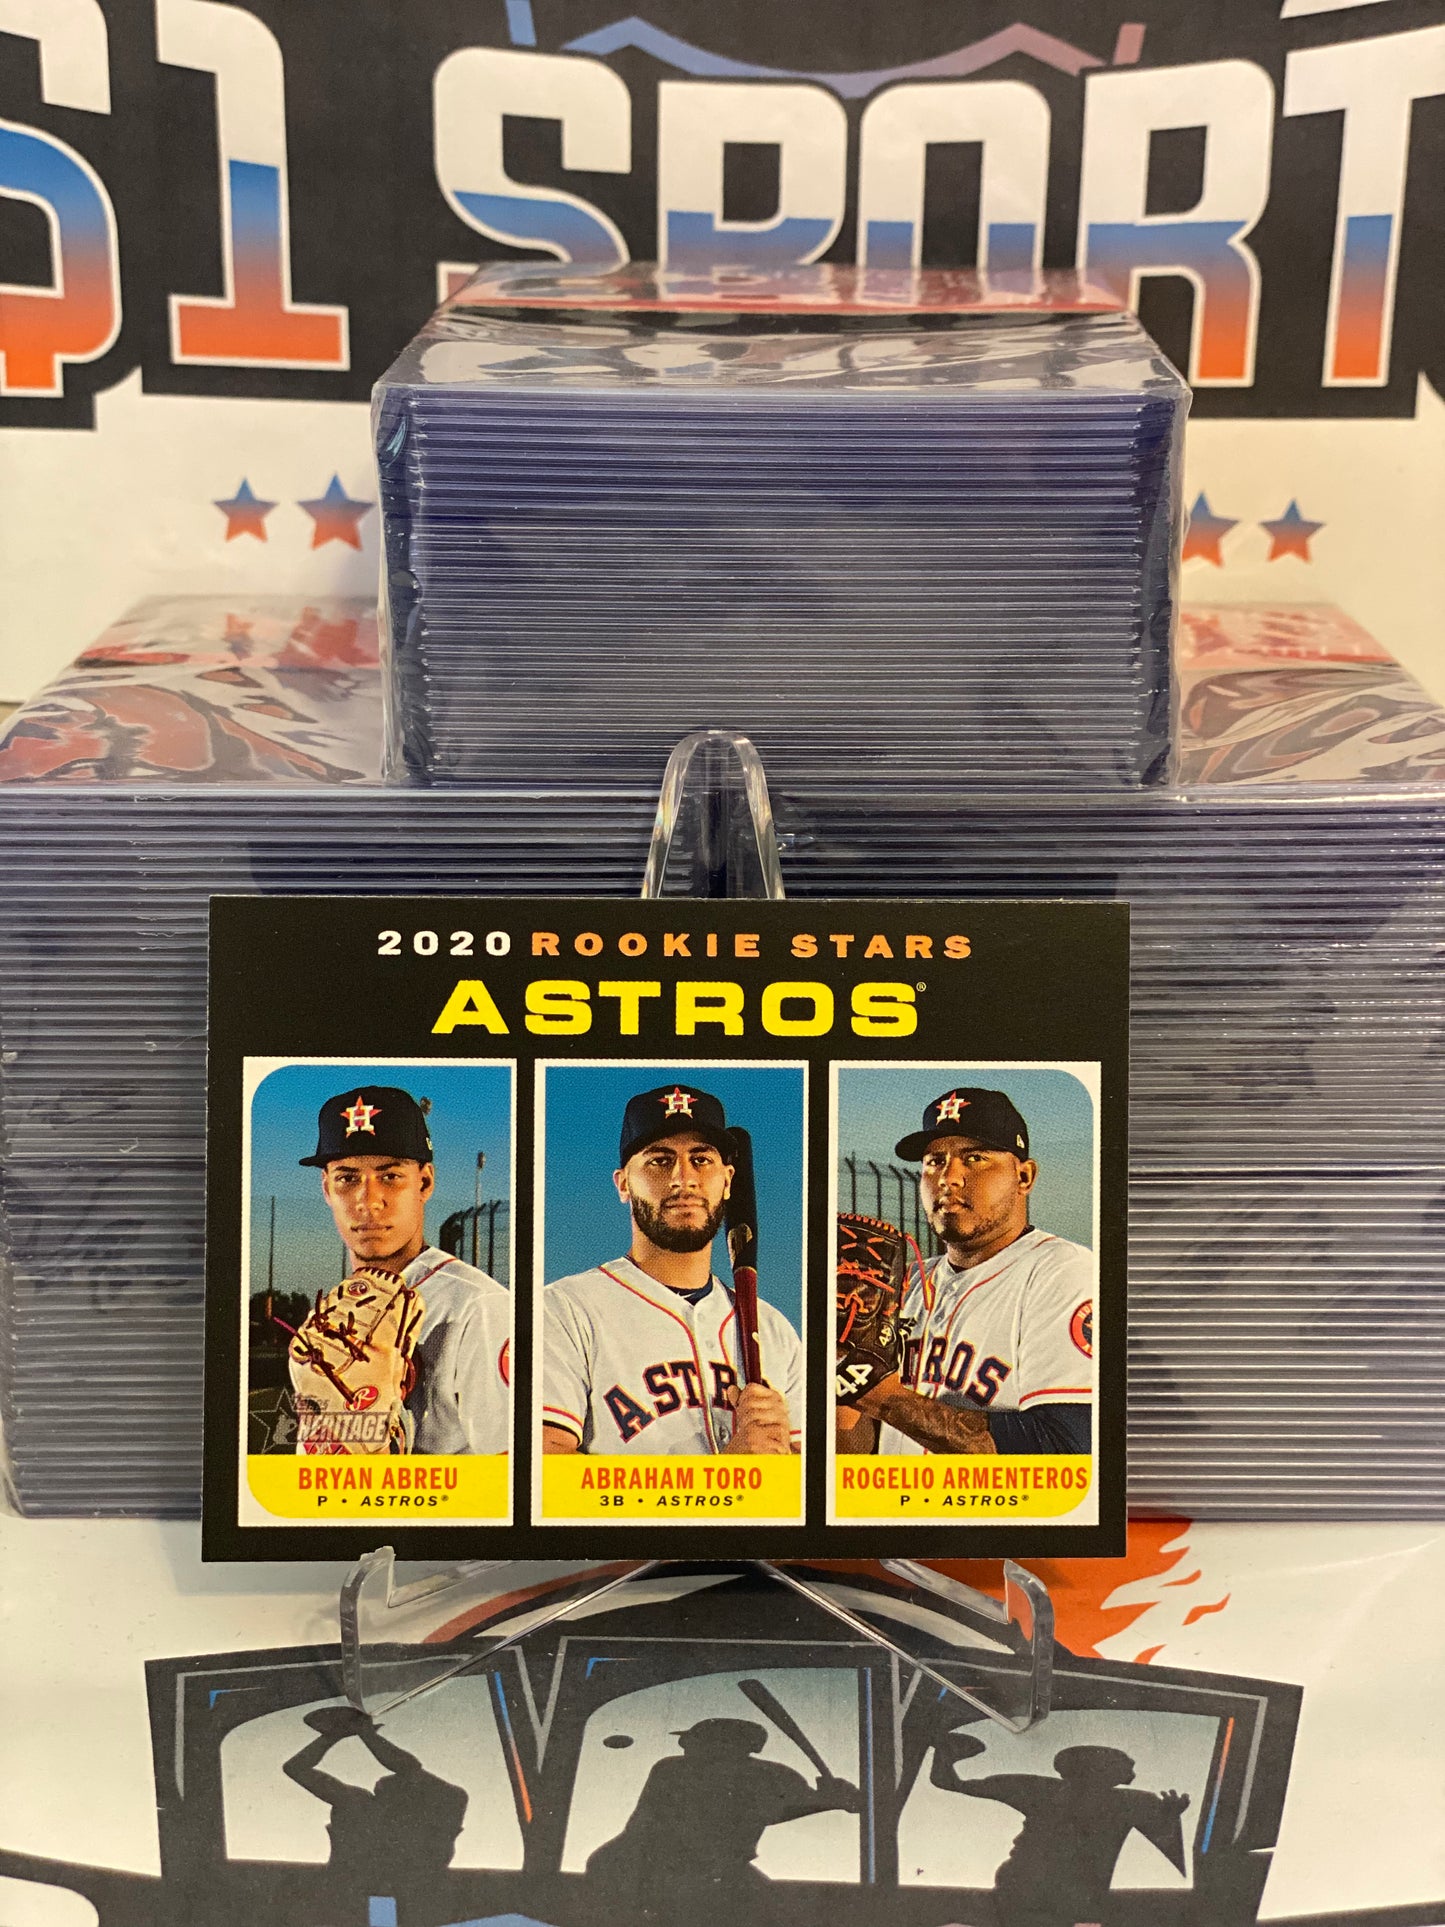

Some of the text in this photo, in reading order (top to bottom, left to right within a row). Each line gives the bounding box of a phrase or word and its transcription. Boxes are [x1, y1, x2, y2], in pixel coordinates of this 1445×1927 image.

[377, 930, 972, 959] 2020 ROOKIE STARS
[836, 1363, 874, 1397] 44
[297, 1413, 389, 1442] HERITAGE
[298, 1467, 458, 1490] BRYAN ABREU
[581, 1467, 763, 1490] ABRAHAM TORO
[842, 1467, 1088, 1490] ROGELIO ARMENTEROS
[317, 1496, 328, 1507] P
[600, 1495, 625, 1507] 3B
[900, 1495, 911, 1506] P
